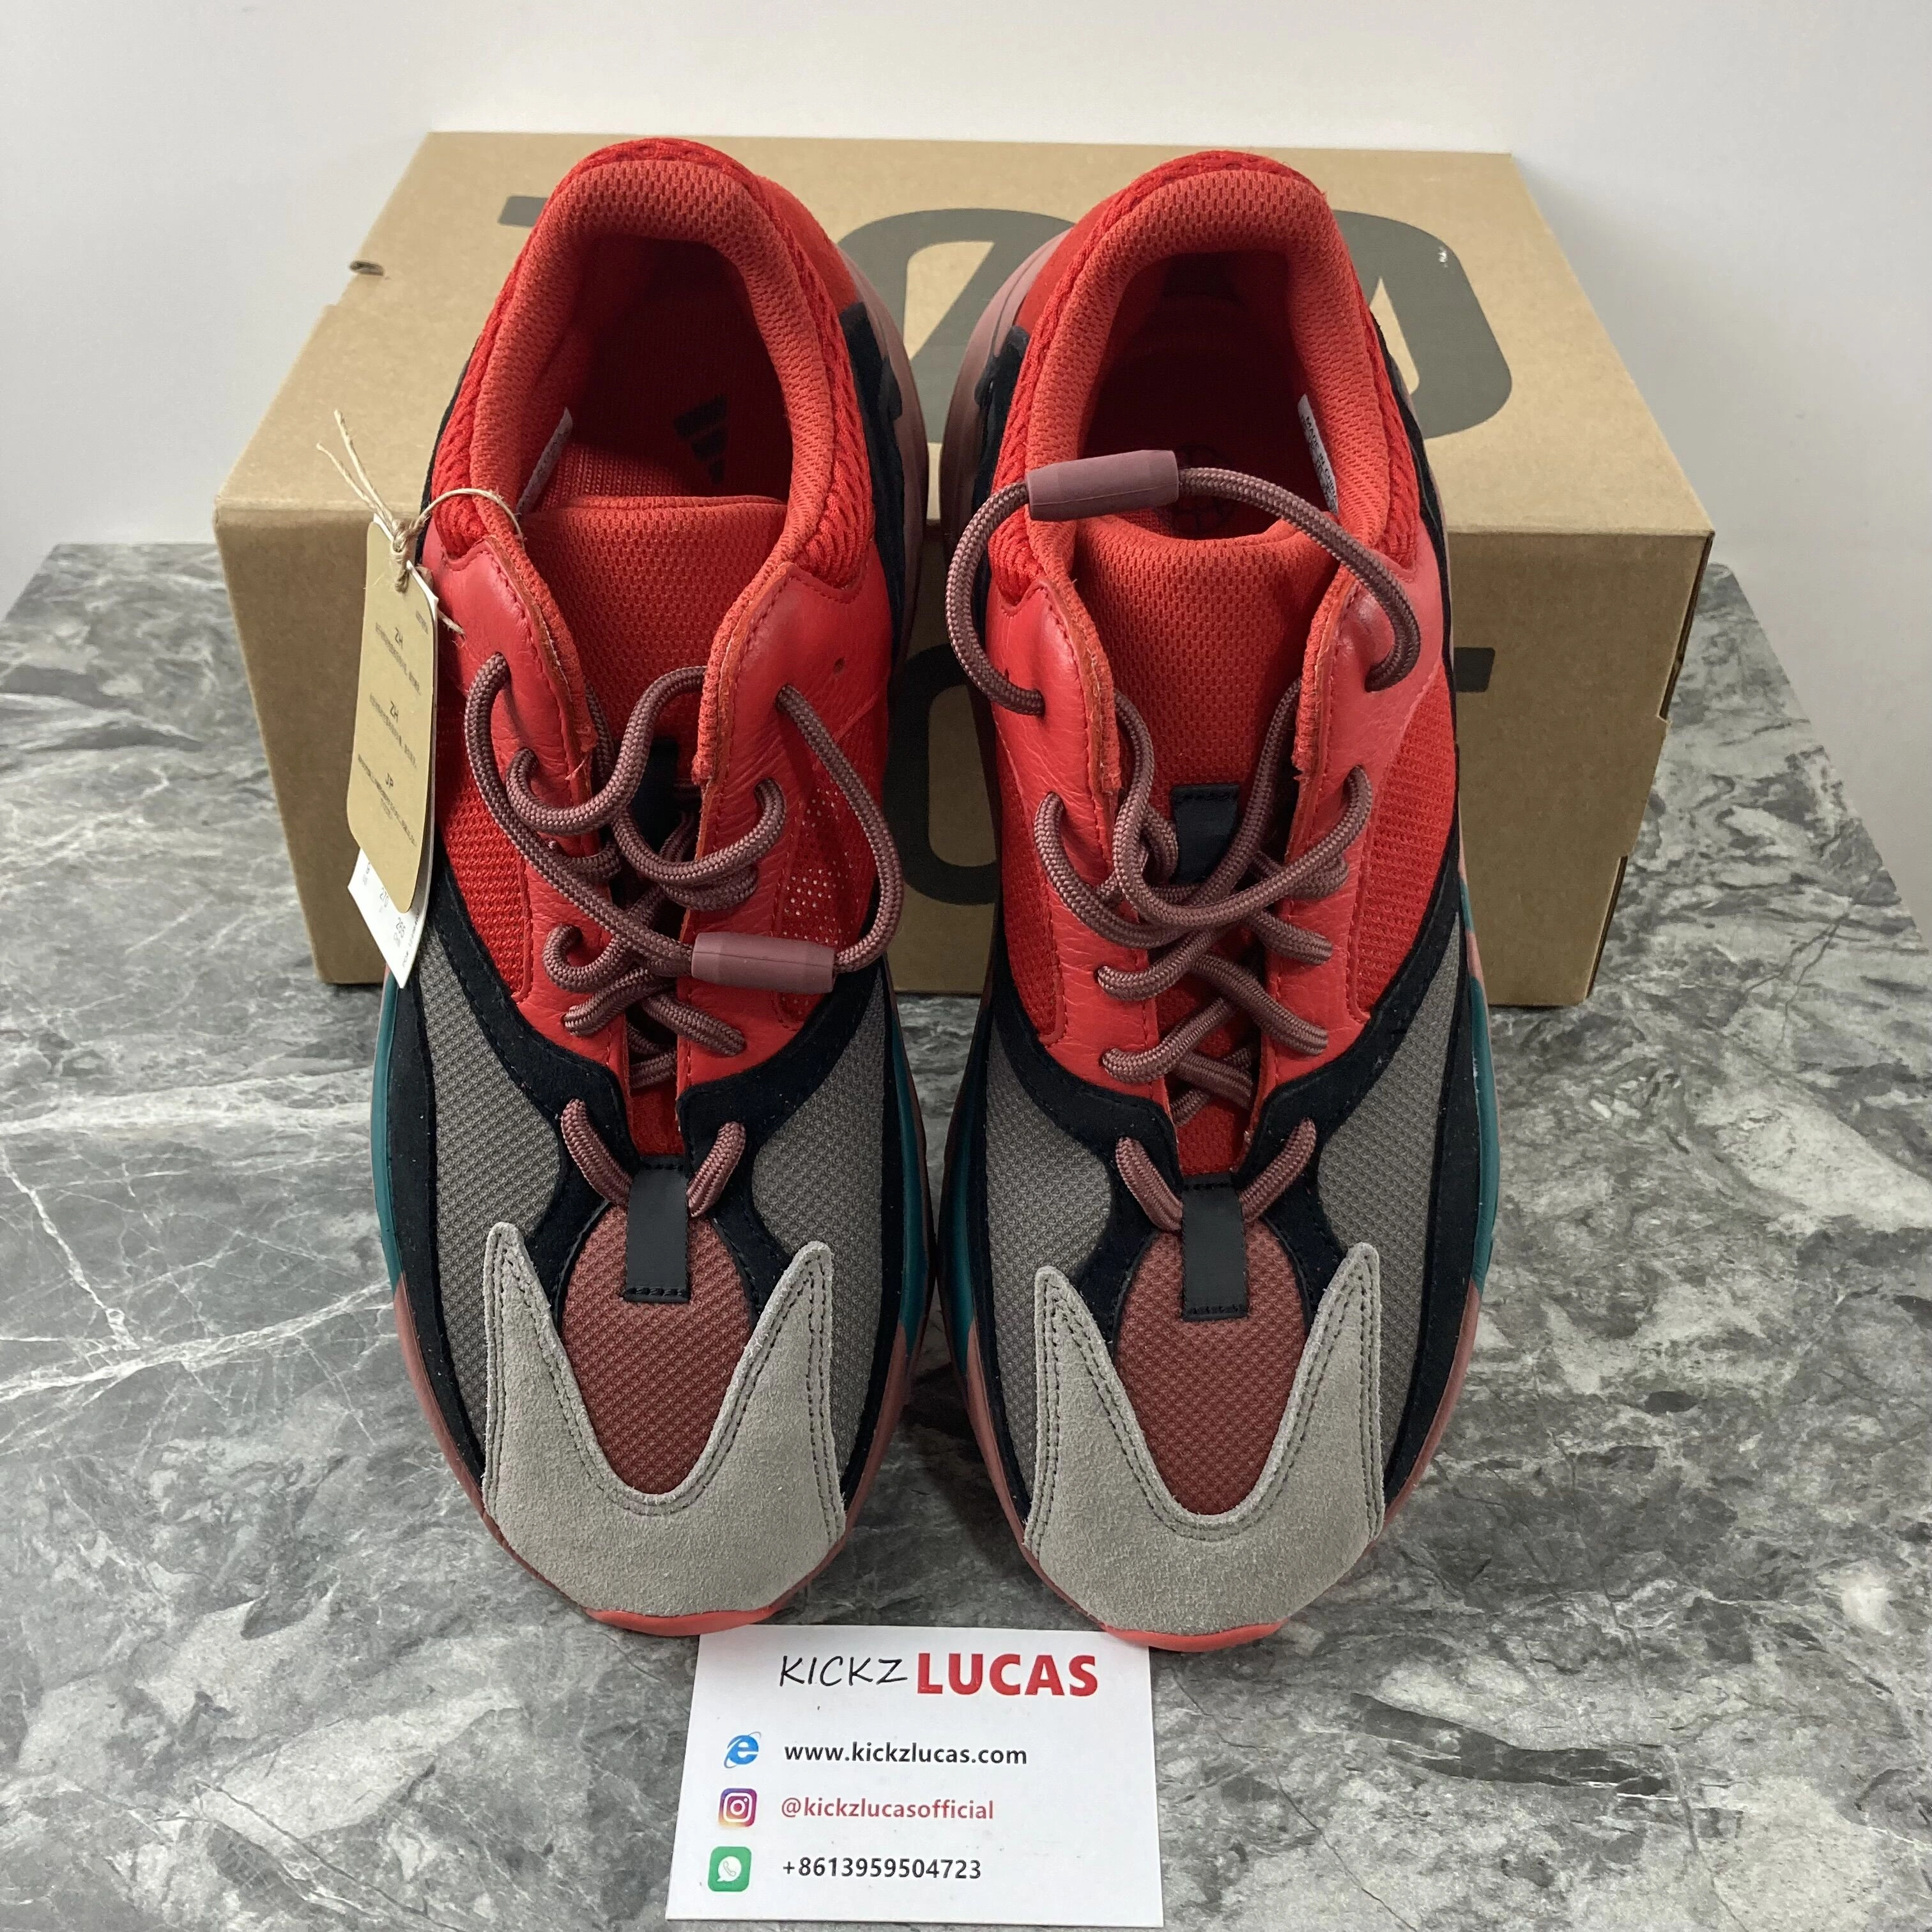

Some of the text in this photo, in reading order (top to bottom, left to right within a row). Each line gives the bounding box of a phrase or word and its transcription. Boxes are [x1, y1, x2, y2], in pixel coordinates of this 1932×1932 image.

[779, 1653, 1098, 1697] KICKZ LUCAS
[785, 1741, 1027, 1765] www.kickzlucas.com
[781, 1797, 993, 1820] @kickzlucasofficial
[783, 1857, 981, 1879] +8613959504723
